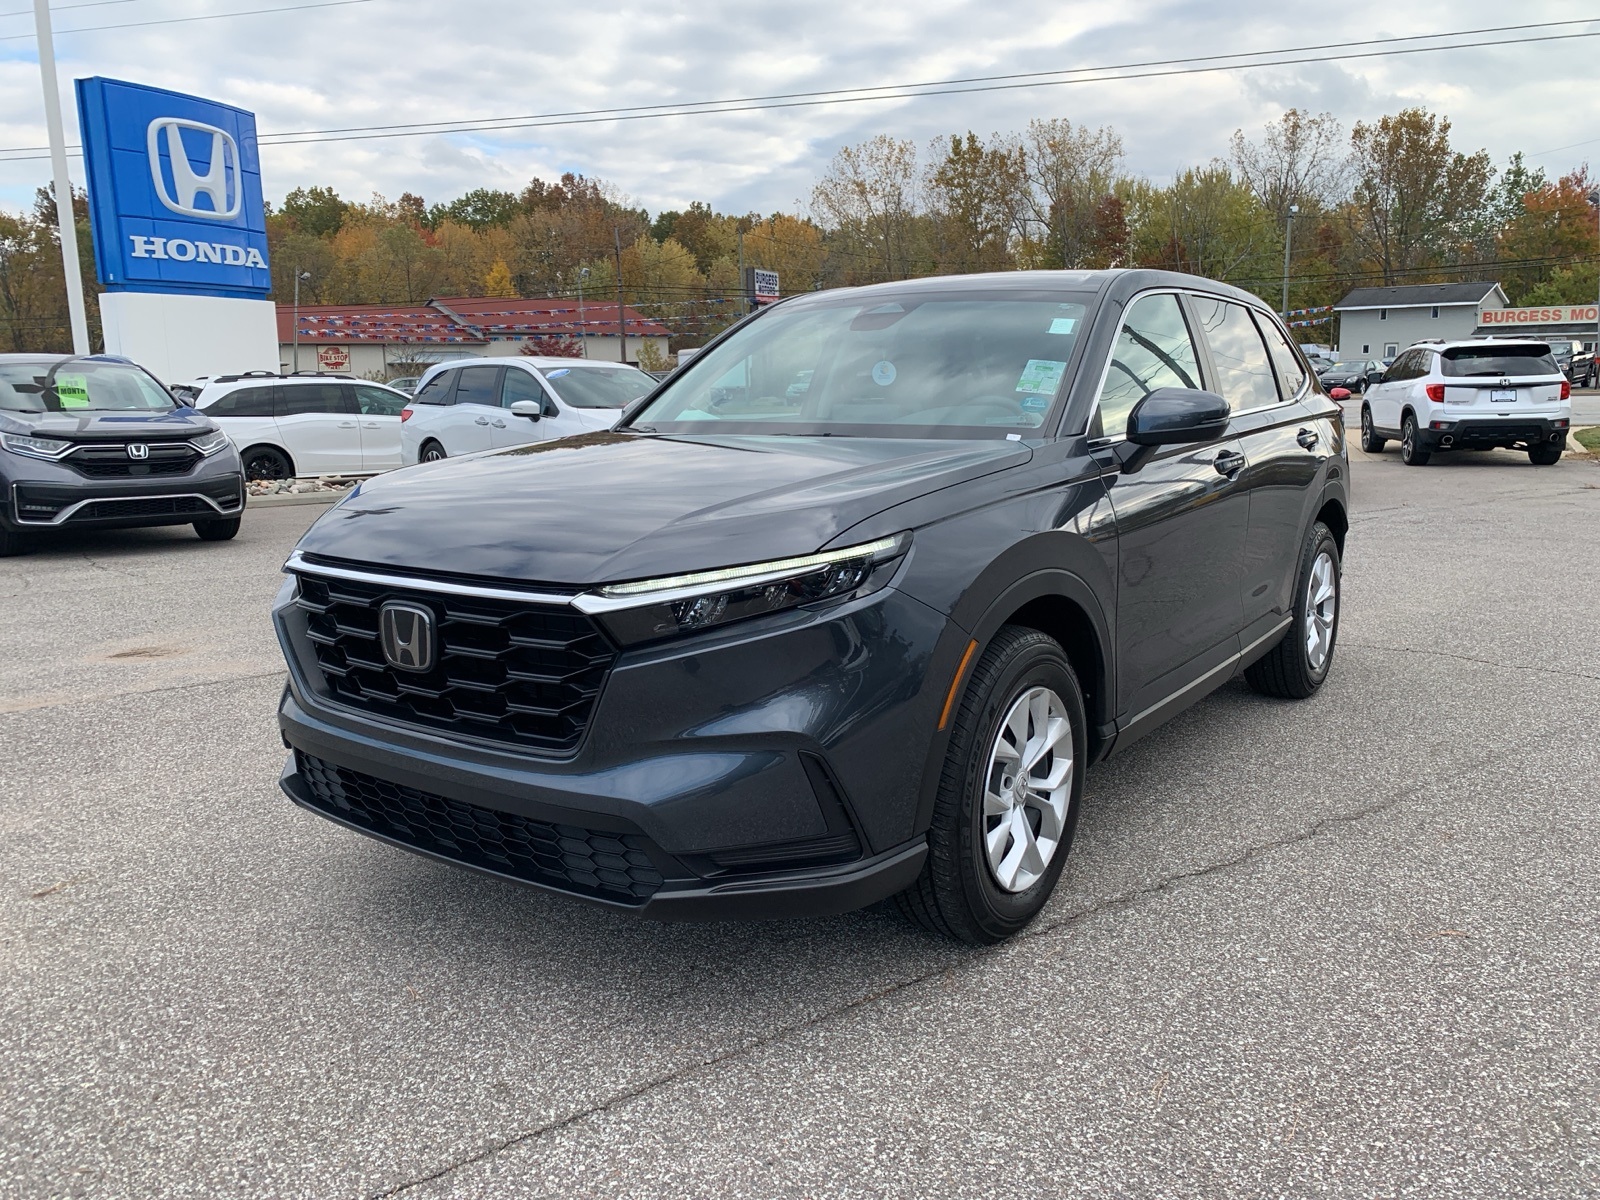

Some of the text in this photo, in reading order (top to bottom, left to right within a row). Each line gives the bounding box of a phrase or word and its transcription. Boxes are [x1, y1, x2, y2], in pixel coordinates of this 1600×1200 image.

[129, 235, 268, 270] HONDA
[1482, 309, 1562, 323] BURGESS
[320, 354, 348, 362] BIKE STOP
[60, 387, 86, 395] MONTH
